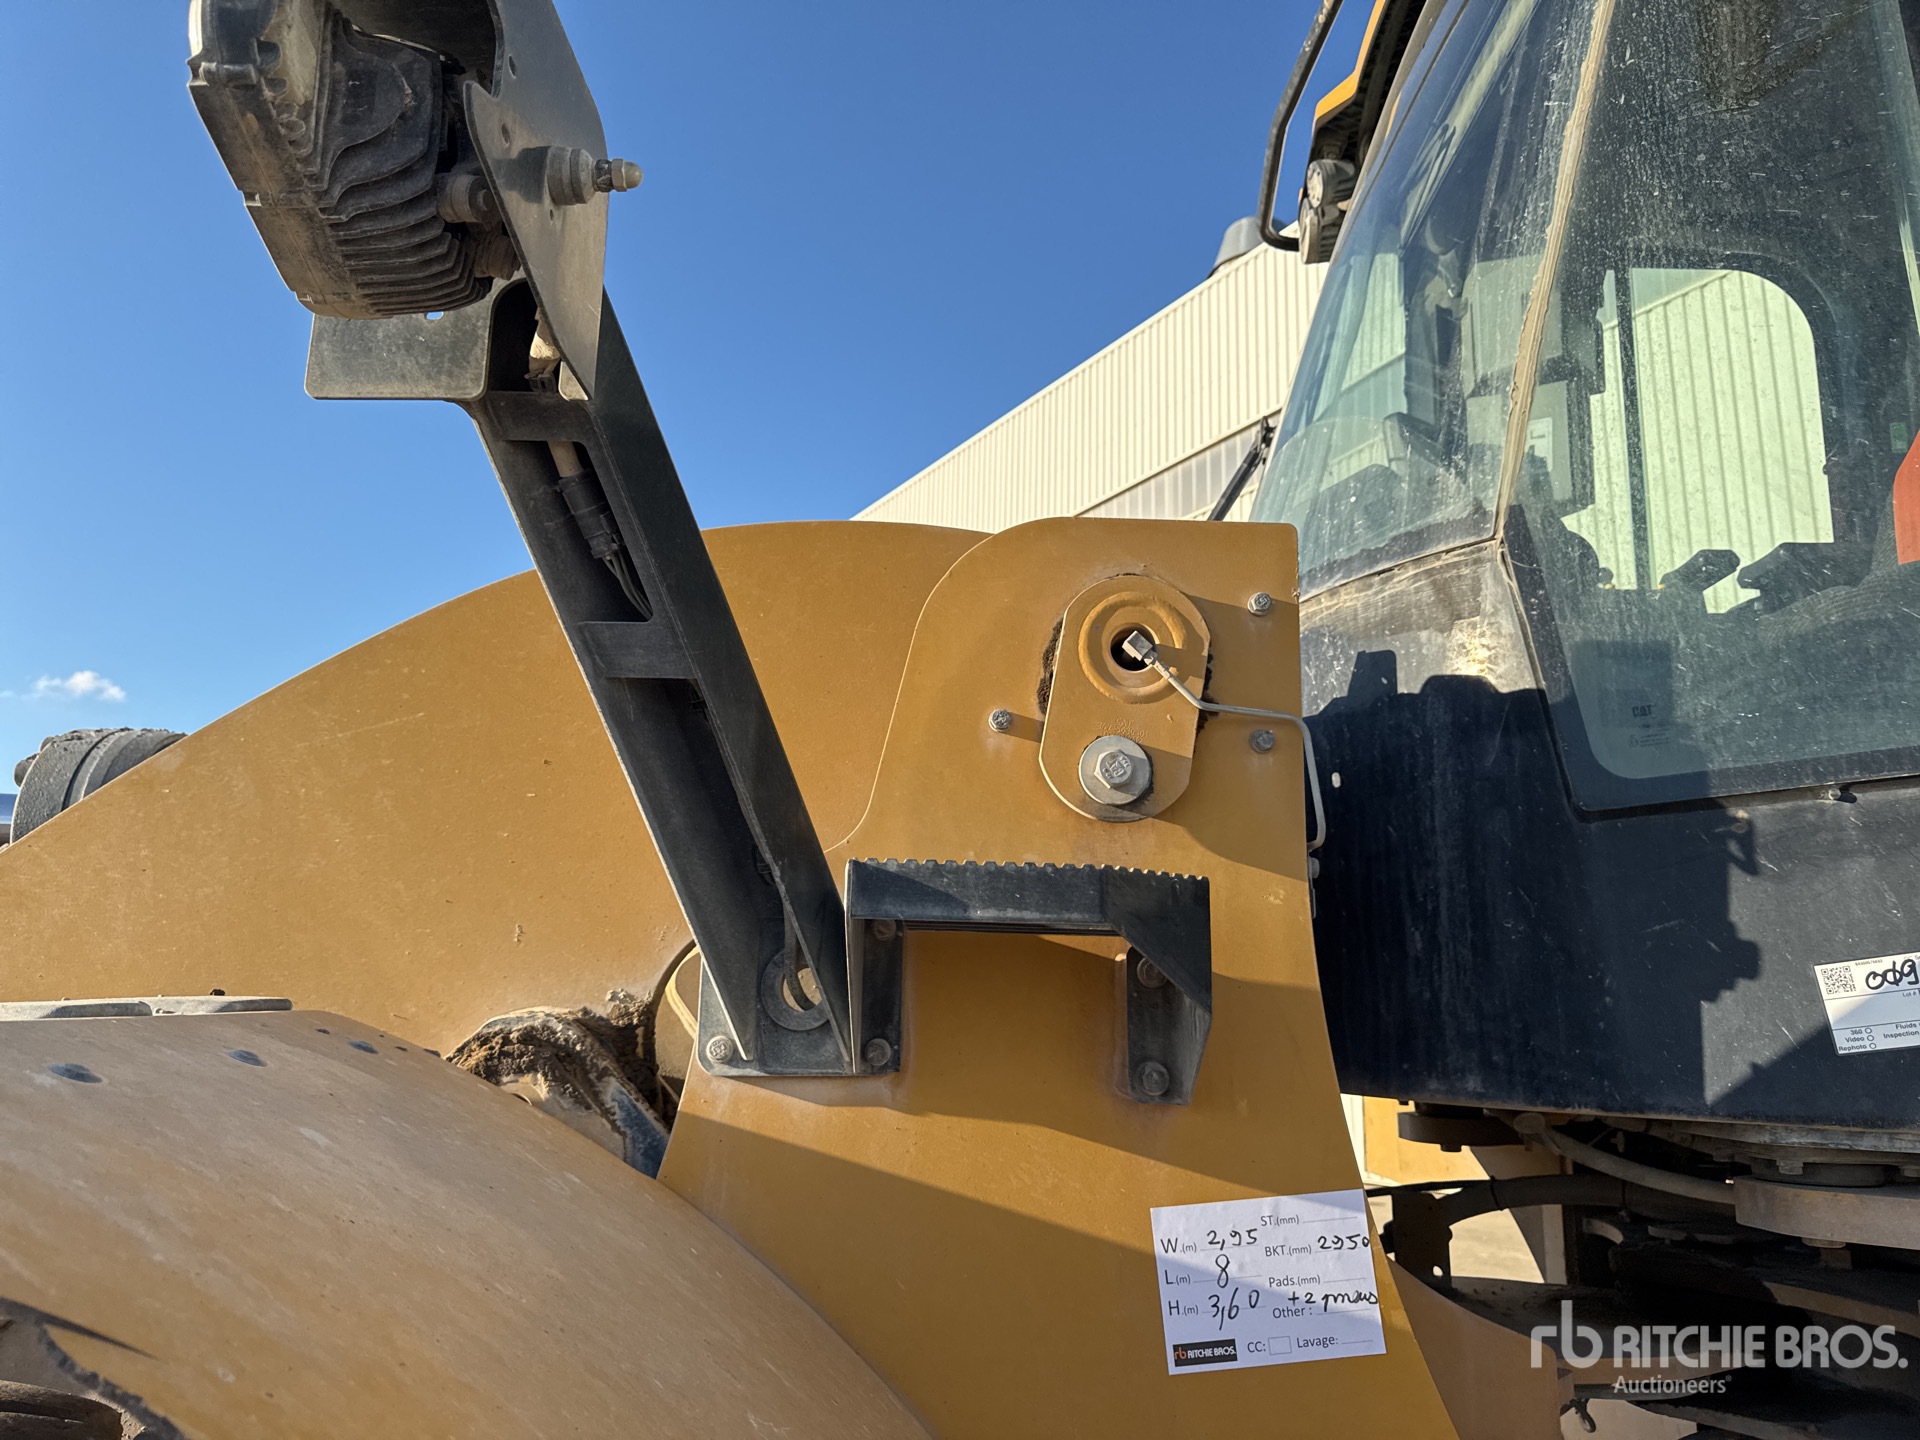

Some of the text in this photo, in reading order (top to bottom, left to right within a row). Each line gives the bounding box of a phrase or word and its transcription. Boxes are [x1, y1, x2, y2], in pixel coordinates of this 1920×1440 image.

[1632, 704, 1652, 717] CAT
[1883, 1030, 1919, 1039] Inspection
[1215, 1253, 1231, 1288] 8
[1247, 1341, 1266, 1353] CC:
[1296, 1336, 1338, 1349] Lavage:
[1187, 1348, 1214, 1359] RITCHIE
